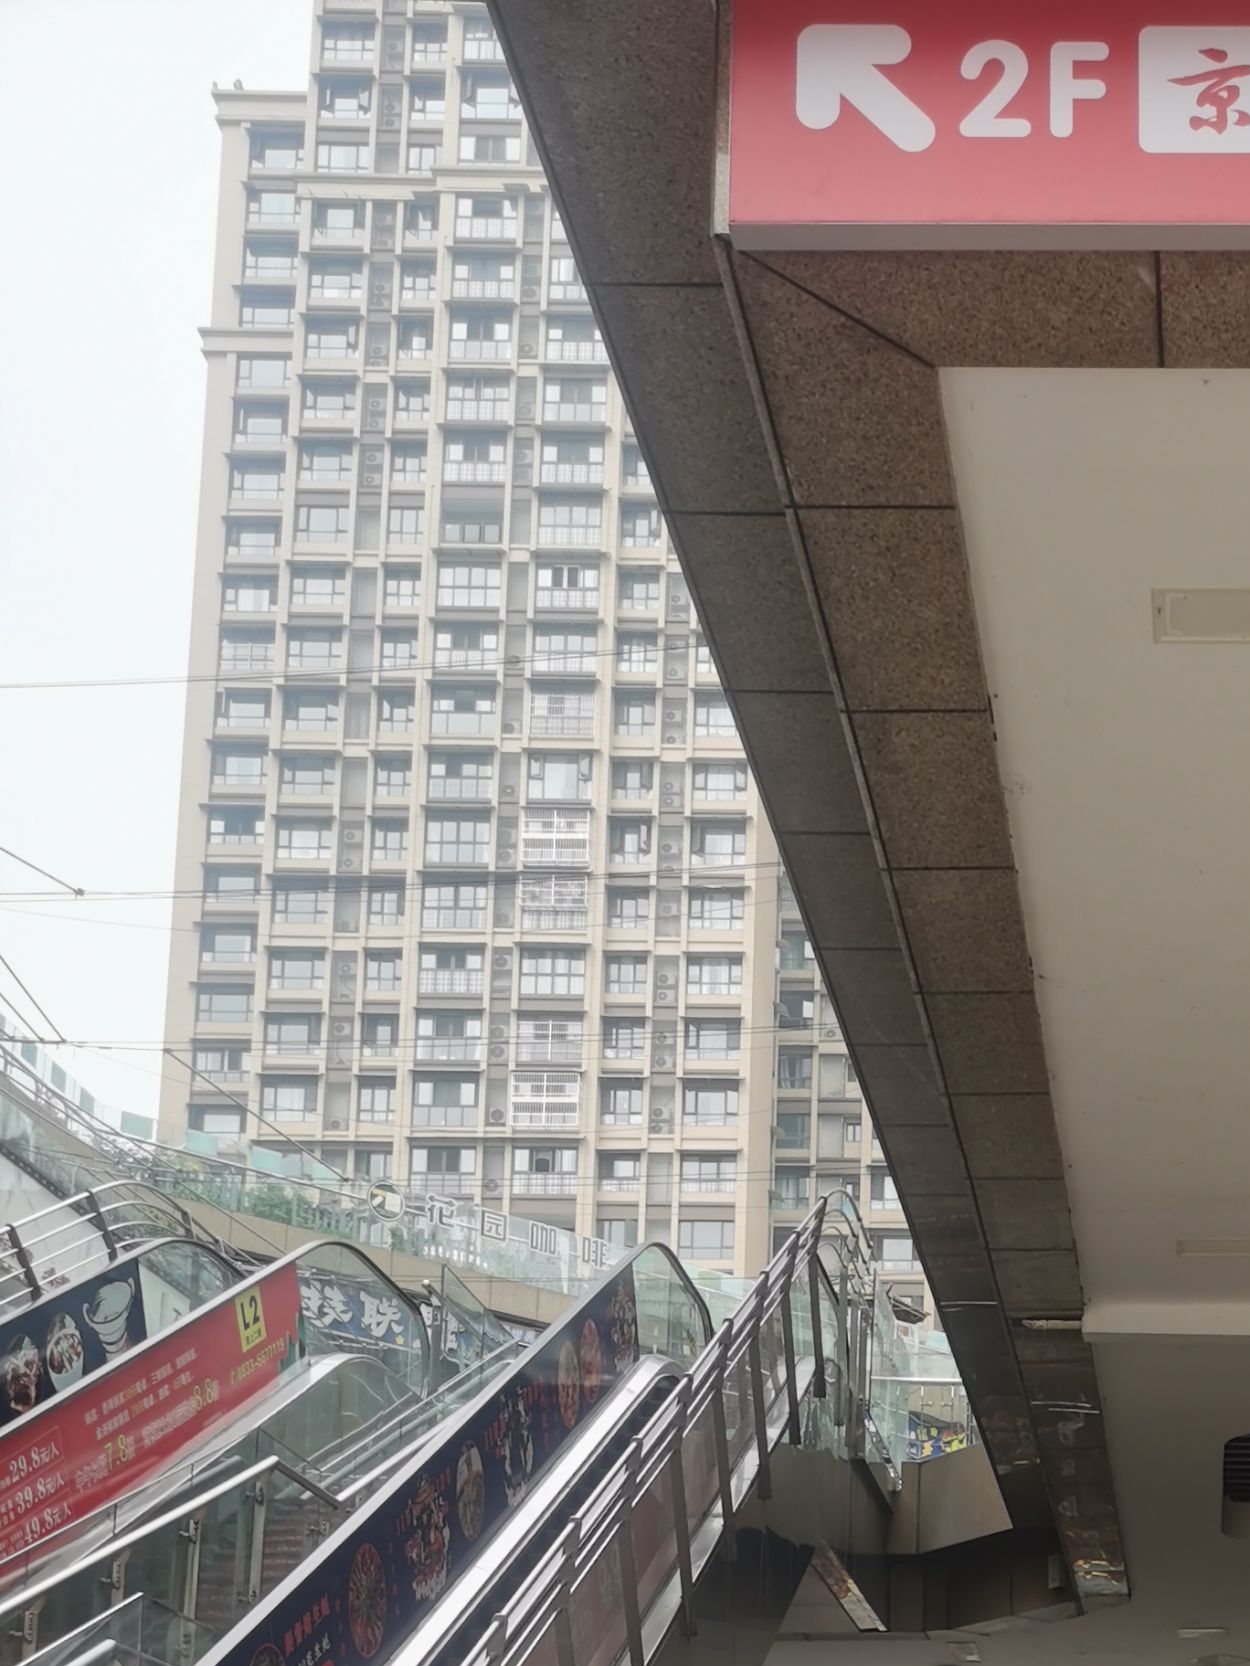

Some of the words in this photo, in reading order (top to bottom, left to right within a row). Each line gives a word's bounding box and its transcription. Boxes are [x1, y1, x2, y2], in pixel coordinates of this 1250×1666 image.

[960, 40, 1110, 138] 2F
[427, 1194, 610, 1271] 花园咖啡
[240, 1295, 261, 1331] L2
